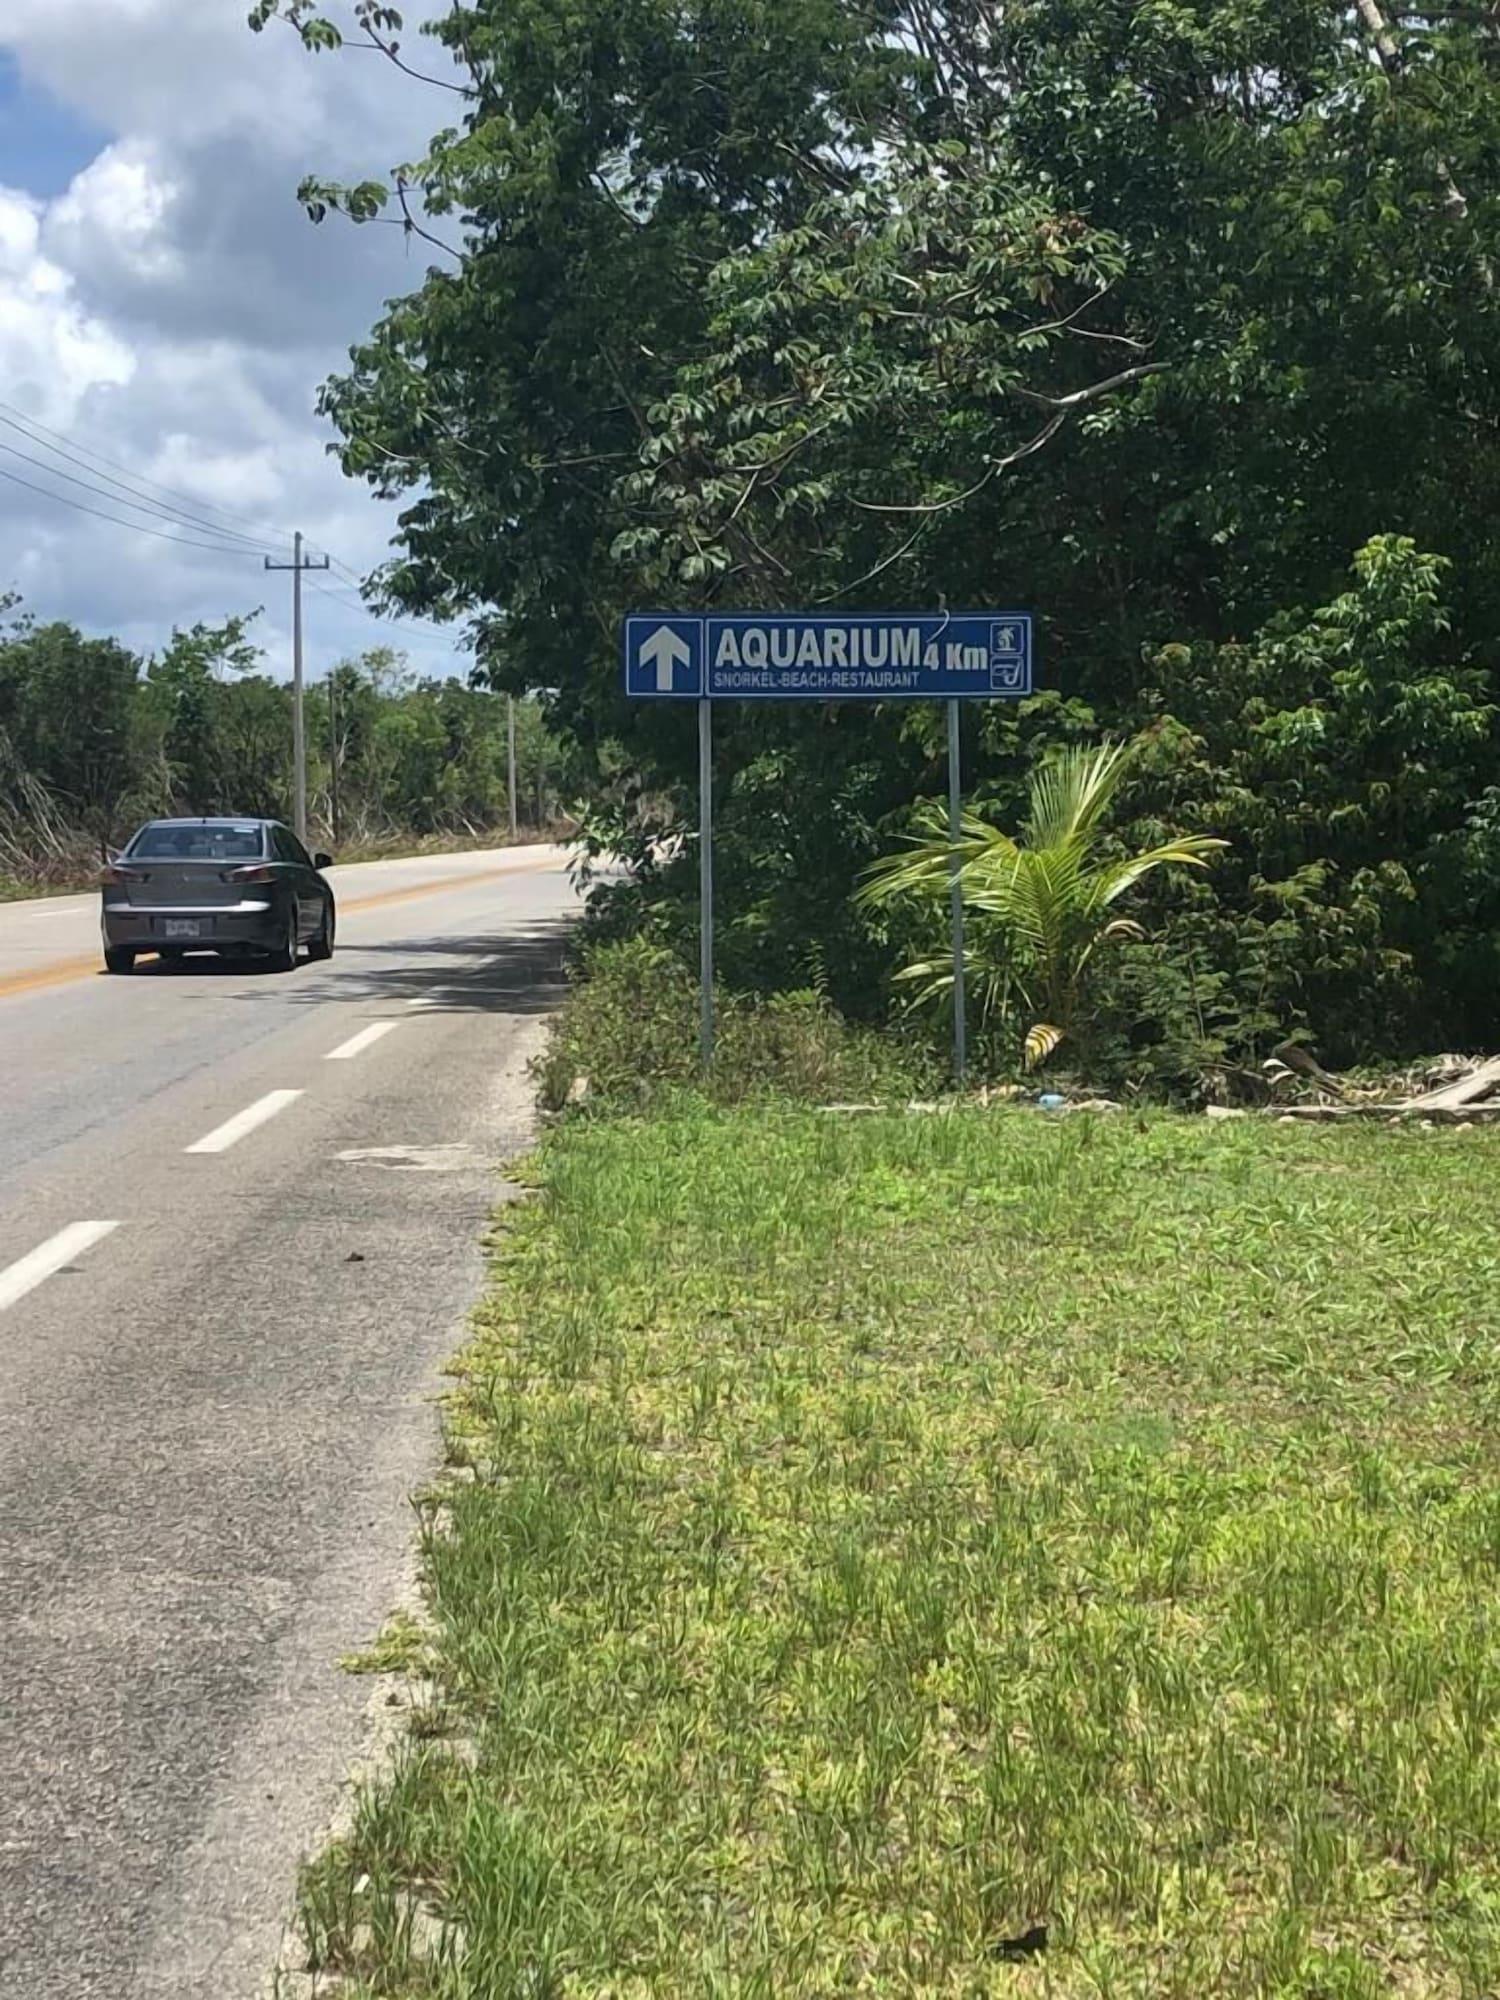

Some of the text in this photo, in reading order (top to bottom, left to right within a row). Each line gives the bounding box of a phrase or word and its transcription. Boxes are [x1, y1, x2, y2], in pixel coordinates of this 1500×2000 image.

[714, 627, 988, 670] AQUARIUM 4 Km
[714, 671, 920, 688] SNORKEL-BEACH-RESTAURANT
